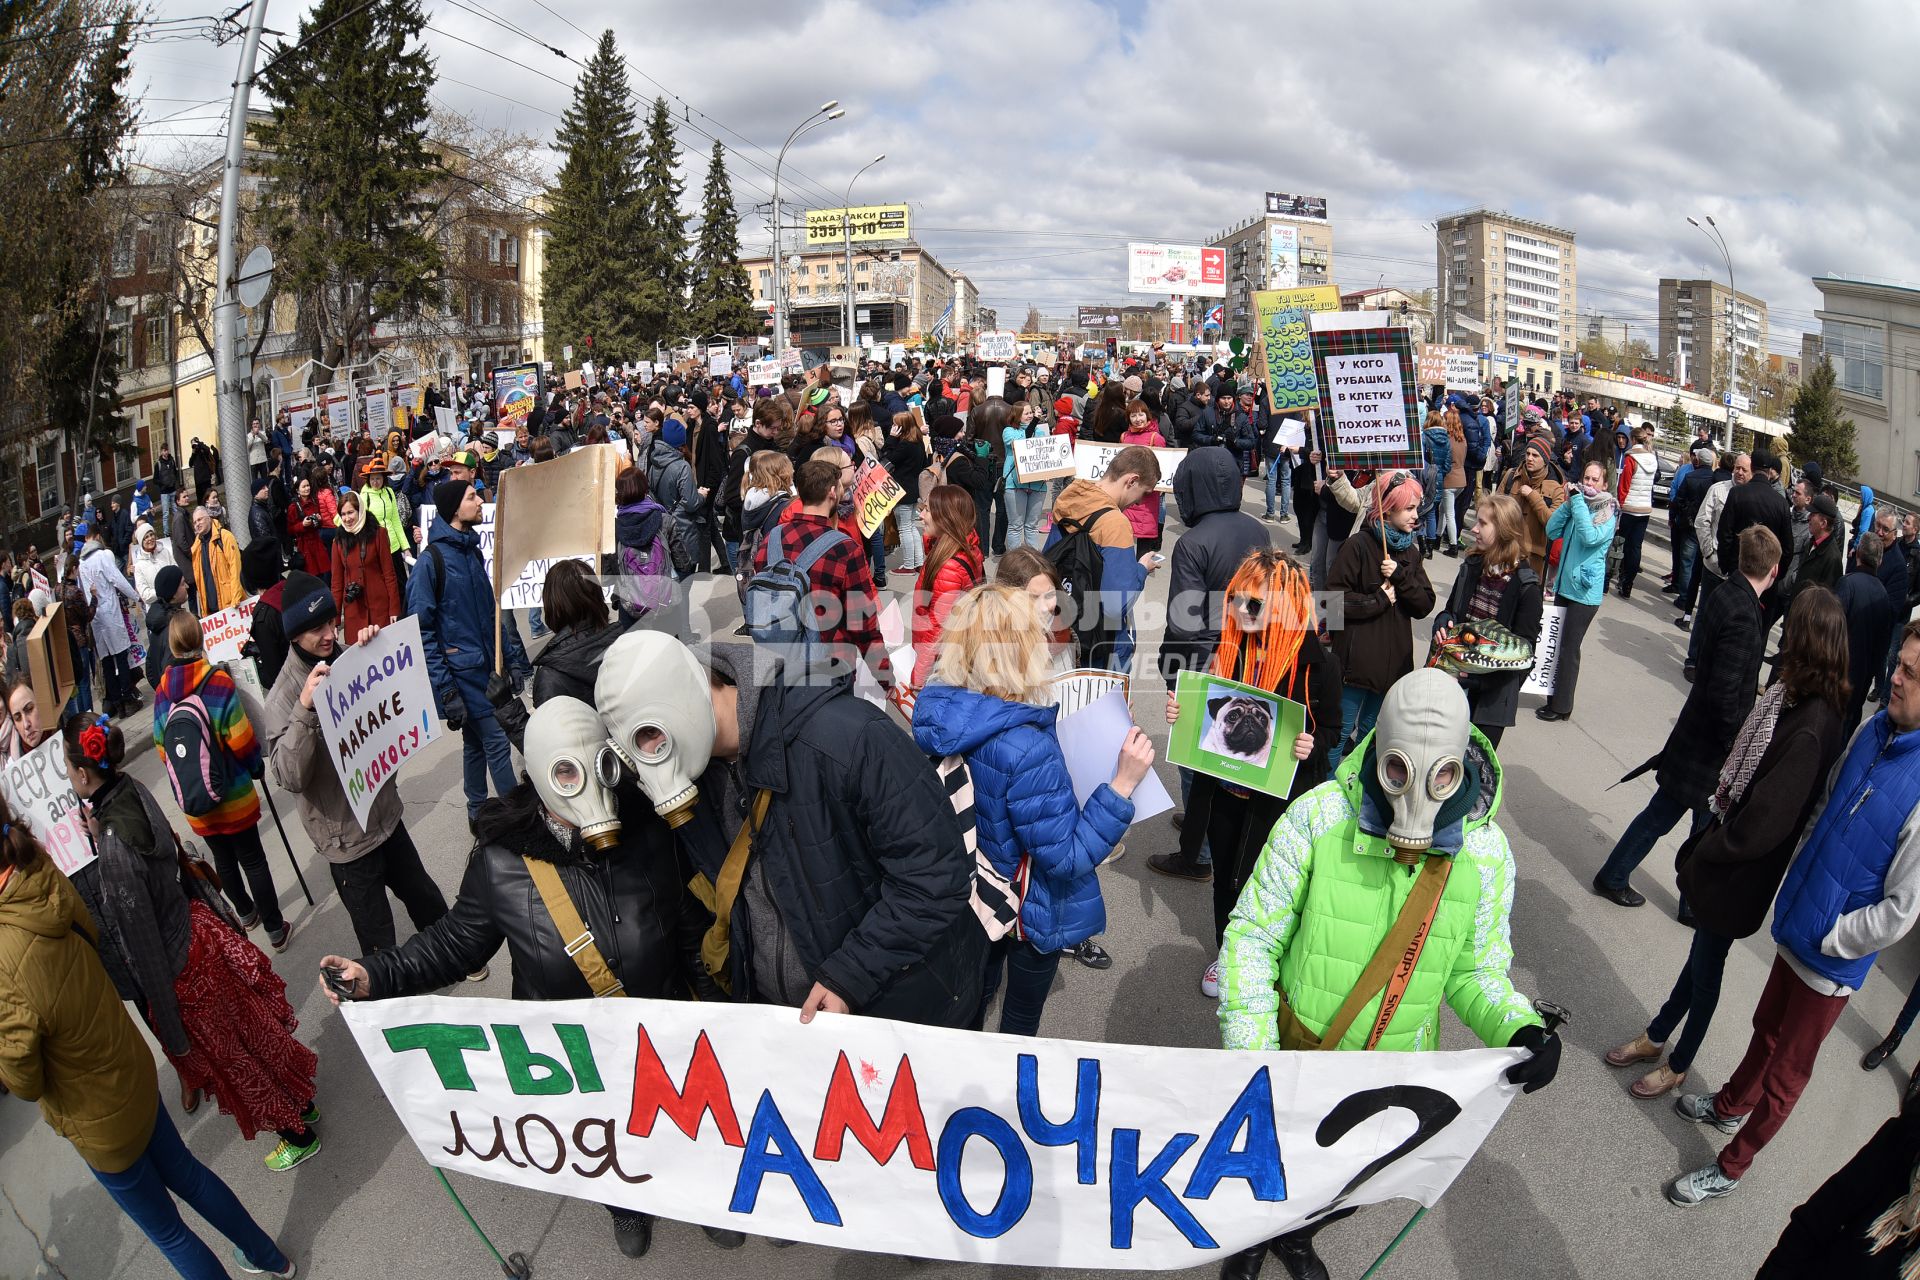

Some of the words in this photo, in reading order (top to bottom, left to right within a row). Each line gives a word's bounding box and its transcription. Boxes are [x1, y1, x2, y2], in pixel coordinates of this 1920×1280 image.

[1339, 361, 1346, 370] У
[1352, 359, 1384, 369] КОГО
[1335, 374, 1392, 385] РУБАШКА
[1338, 393, 1346, 402] В
[1349, 391, 1393, 402] КЛЕТКУ
[1356, 404, 1379, 414] ТОТ
[1337, 419, 1382, 430] ПОХОЖ
[1385, 418, 1402, 428] НА
[1338, 434, 1406, 445] ТАБУРЕТКУ!
[860, 476, 901, 531] КРАСИВО
[201, 612, 228, 635] МЫ
[1538, 615, 1561, 688] МОНСТРАЦИЯ
[325, 642, 414, 729] КАЖДОЙ
[338, 691, 405, 774] МАКАКЕ
[382, 1022, 606, 1096] ТЫ
